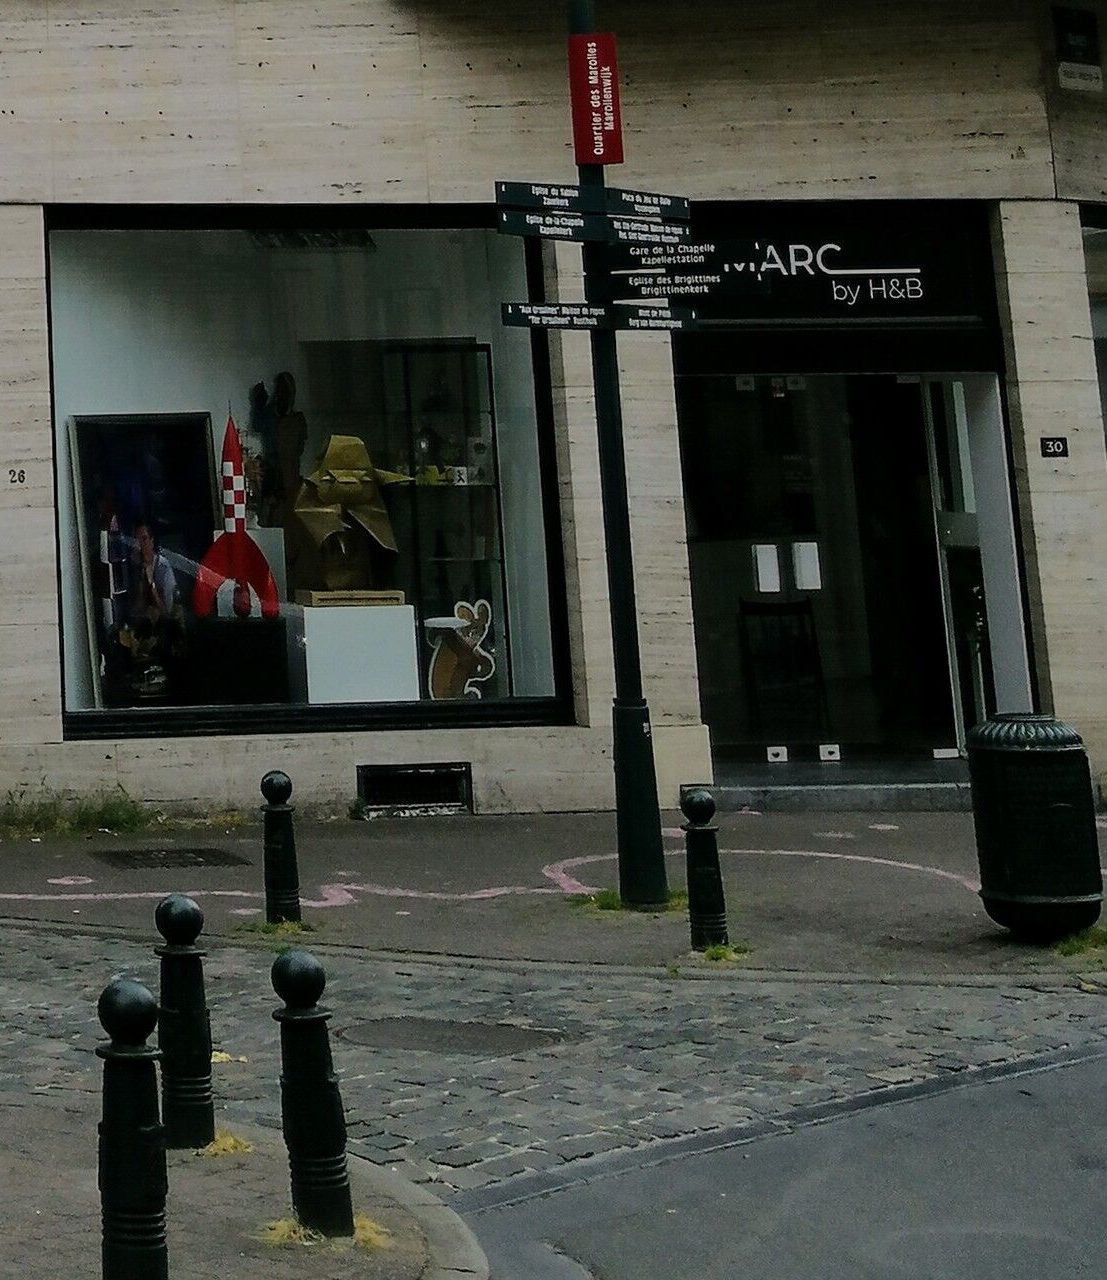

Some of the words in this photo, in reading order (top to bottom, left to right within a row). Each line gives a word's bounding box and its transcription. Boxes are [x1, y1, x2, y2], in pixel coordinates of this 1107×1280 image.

[587, 42, 599, 85] Marolles
[590, 89, 601, 108] des
[600, 66, 614, 130] Marollenwijk
[593, 112, 604, 155] Quartier
[630, 246, 649, 255] Gare
[652, 245, 663, 254] de
[666, 244, 674, 254] la
[677, 243, 715, 255] Chapelle
[641, 254, 704, 265] Kapellestation
[628, 276, 653, 286] Eglise
[656, 275, 672, 285] des
[674, 274, 720, 285] Brigittines
[641, 284, 709, 296] Brigittinenkerk
[832, 280, 860, 305] by
[869, 278, 923, 299] H&B
[1045, 441, 1063, 453] 30
[8, 469, 26, 484] 26
